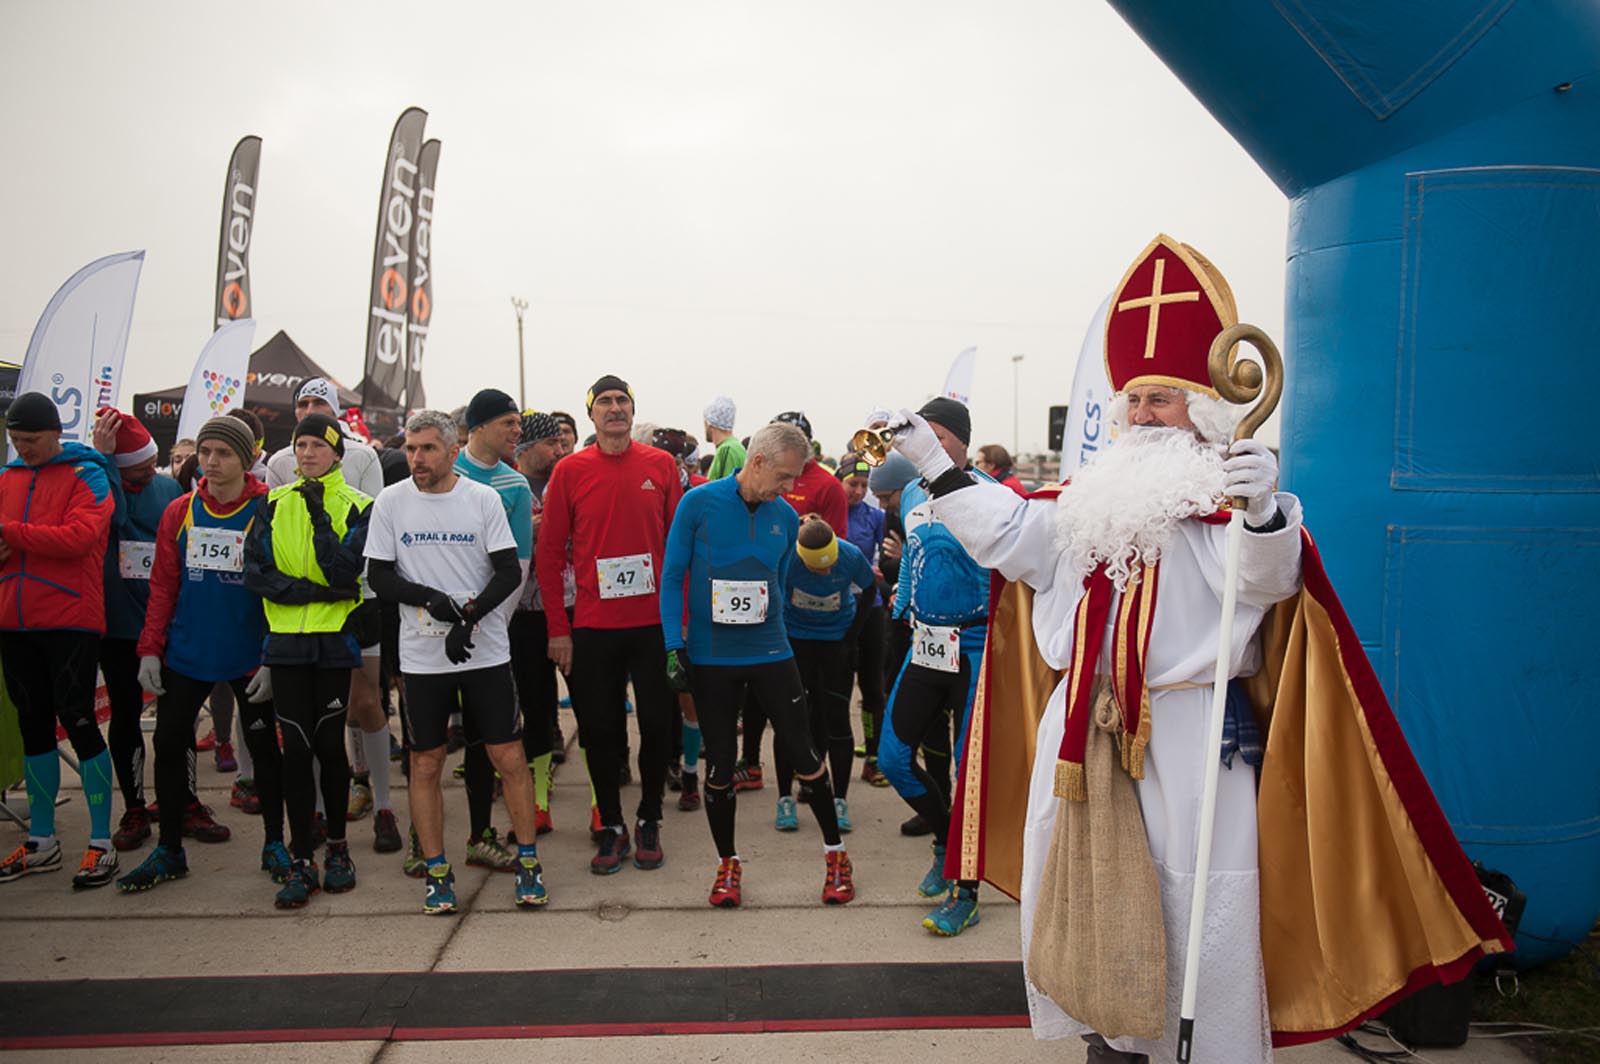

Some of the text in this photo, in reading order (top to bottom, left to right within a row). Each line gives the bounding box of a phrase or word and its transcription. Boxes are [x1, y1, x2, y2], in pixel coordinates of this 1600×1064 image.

[372, 157, 417, 364] eloven
[413, 533, 475, 542] TRAIL & ROAD
[201, 543, 230, 559] 154
[142, 555, 152, 568] 6
[616, 570, 635, 585] 47
[730, 596, 751, 611] 95
[920, 640, 946, 658] 164
